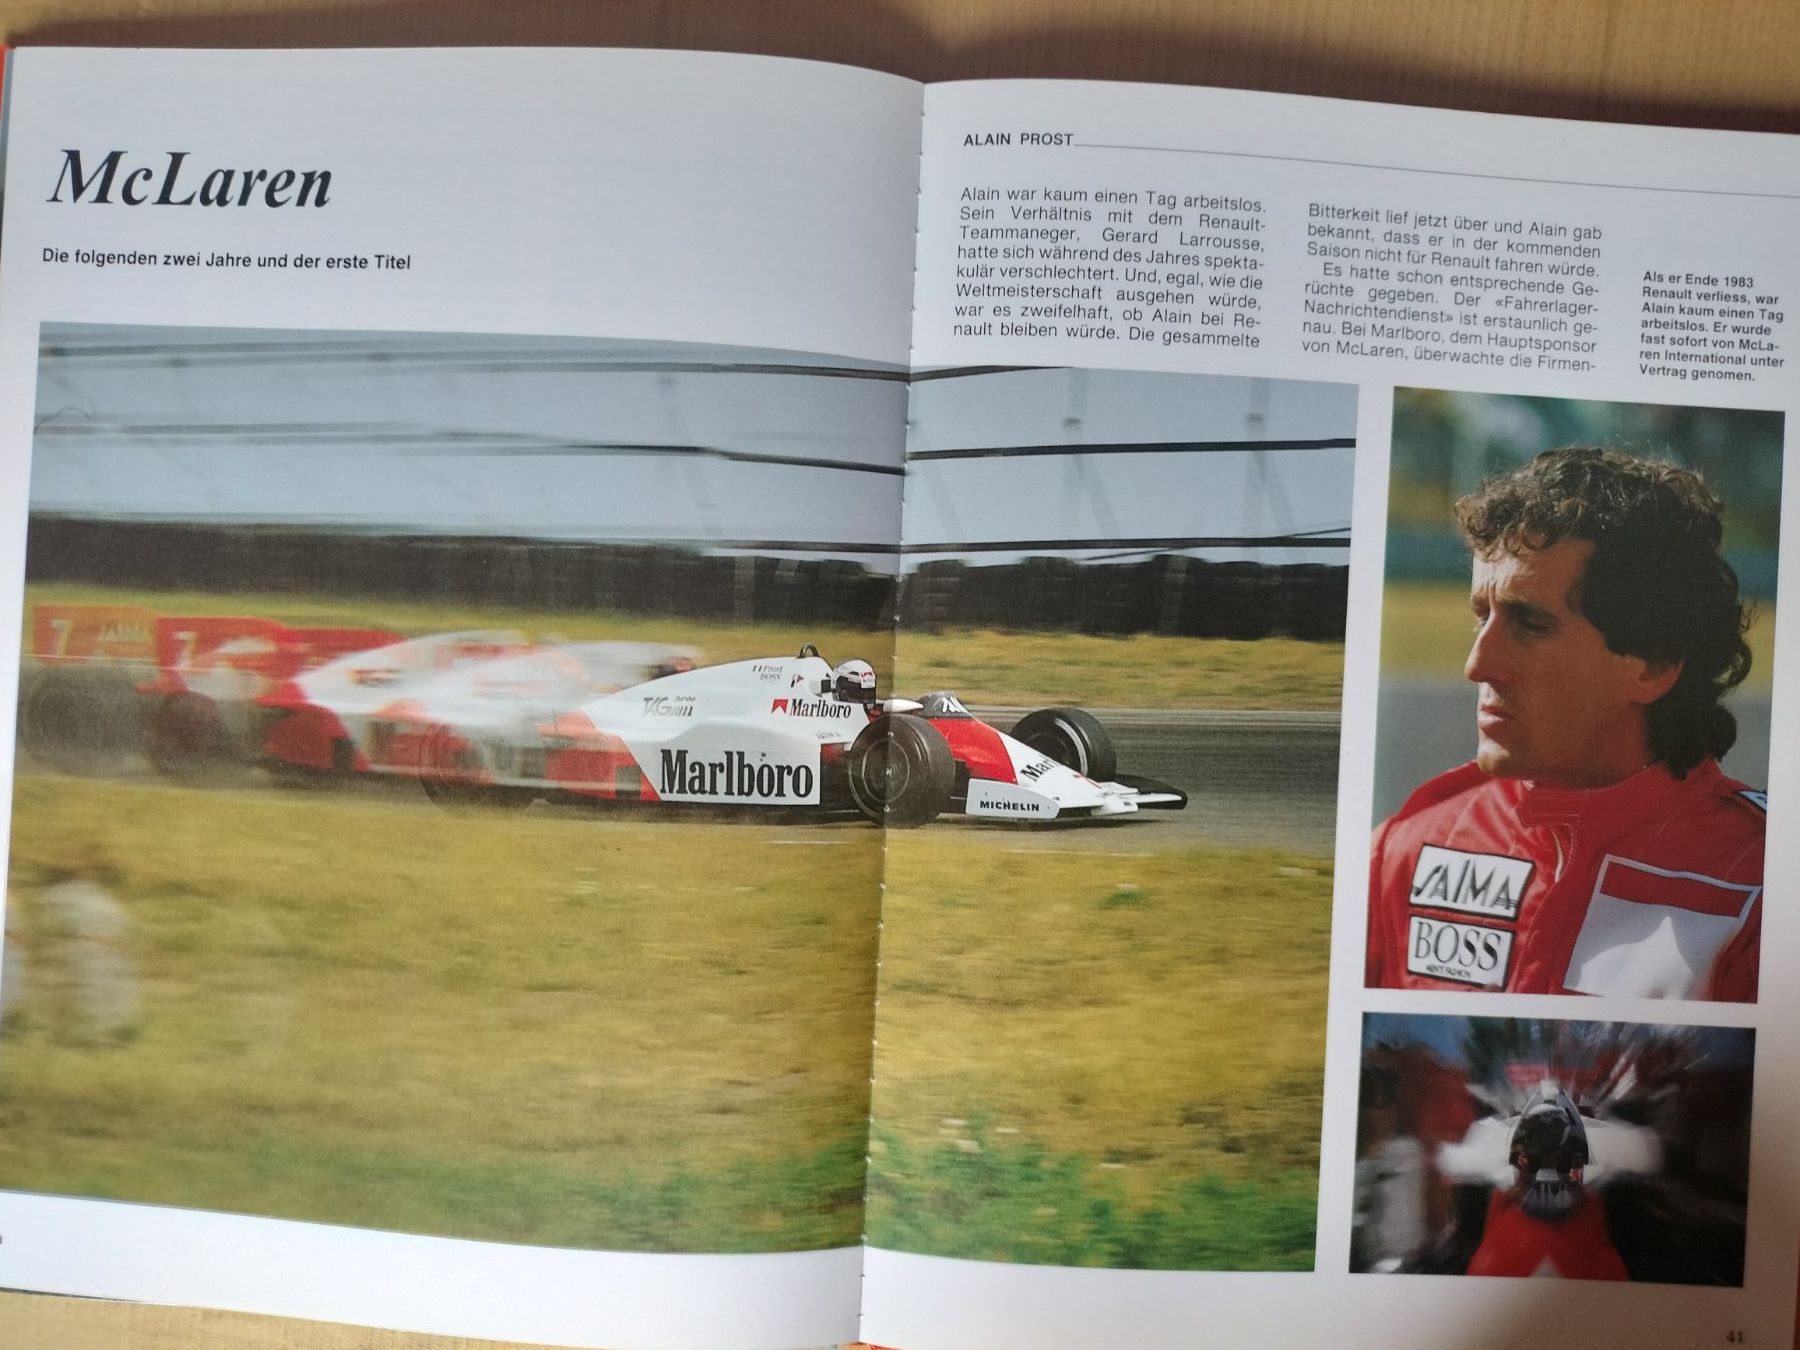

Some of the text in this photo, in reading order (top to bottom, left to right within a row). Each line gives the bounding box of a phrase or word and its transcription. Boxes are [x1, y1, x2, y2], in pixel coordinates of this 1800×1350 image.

[963, 132, 1074, 147] ALAIN PROST
[45, 149, 332, 209] McLaren
[960, 186, 1266, 213] Alain war kaum einen Tag arbeitslos.
[960, 205, 1266, 232] Sein Verhältnis mit dem Renault-
[1309, 203, 1602, 242] Bitterkeit lief jetzt über und Alain gab
[959, 225, 1264, 253] Teammaneger, Gerard Larrousse,
[1307, 222, 1601, 258] bekannt, dass er in der kommenden
[42, 247, 411, 270] Die folgenden zwei Jahre und der erste Titel
[957, 244, 1264, 271] hatte sich während des Jahres spekta-
[1307, 241, 1599, 278] Saison nicht für Renault fahren würde.
[956, 264, 1263, 290] kulär verschlechtert. Und, egal, wie die
[1323, 262, 1599, 296] Es hatte schon entsprechende Ge-
[1643, 270, 1754, 289] Als er Ende 1983
[956, 283, 1261, 311] Weltmeisterschaft ausgehen würde,
[1305, 280, 1598, 318] rüchte gegeben. Der «Fahrerlager-
[1642, 286, 1779, 305] Renault verliess, war
[954, 303, 1261, 328] war es zweifelhaft, ob Alain bei Re-
[1304, 299, 1597, 337] Nachrichtendienst» ist erstaunlich ge-
[1641, 301, 1784, 324] Alain kaum einen Tag
[953, 321, 1260, 348] nault bleiben würde. Die gesammelte
[1303, 321, 1597, 356] nau. Bei Marlboro, dem Hauptsponsor
[1641, 317, 1772, 336] arbeitslos. Er wurde
[1302, 340, 1596, 371] von McLaren, überwachte die Firmen-
[1640, 332, 1779, 352] fast sofort von McLa-
[1639, 349, 1785, 368] ren International unter
[1639, 363, 1755, 382] Vertrag genomen.
[789, 699, 851, 719] Marlboro
[660, 749, 814, 798] Marlboro
[979, 800, 1040, 812] MICHELIN
[1414, 921, 1501, 971] BOSS
[1726, 1330, 1744, 1344] 41
